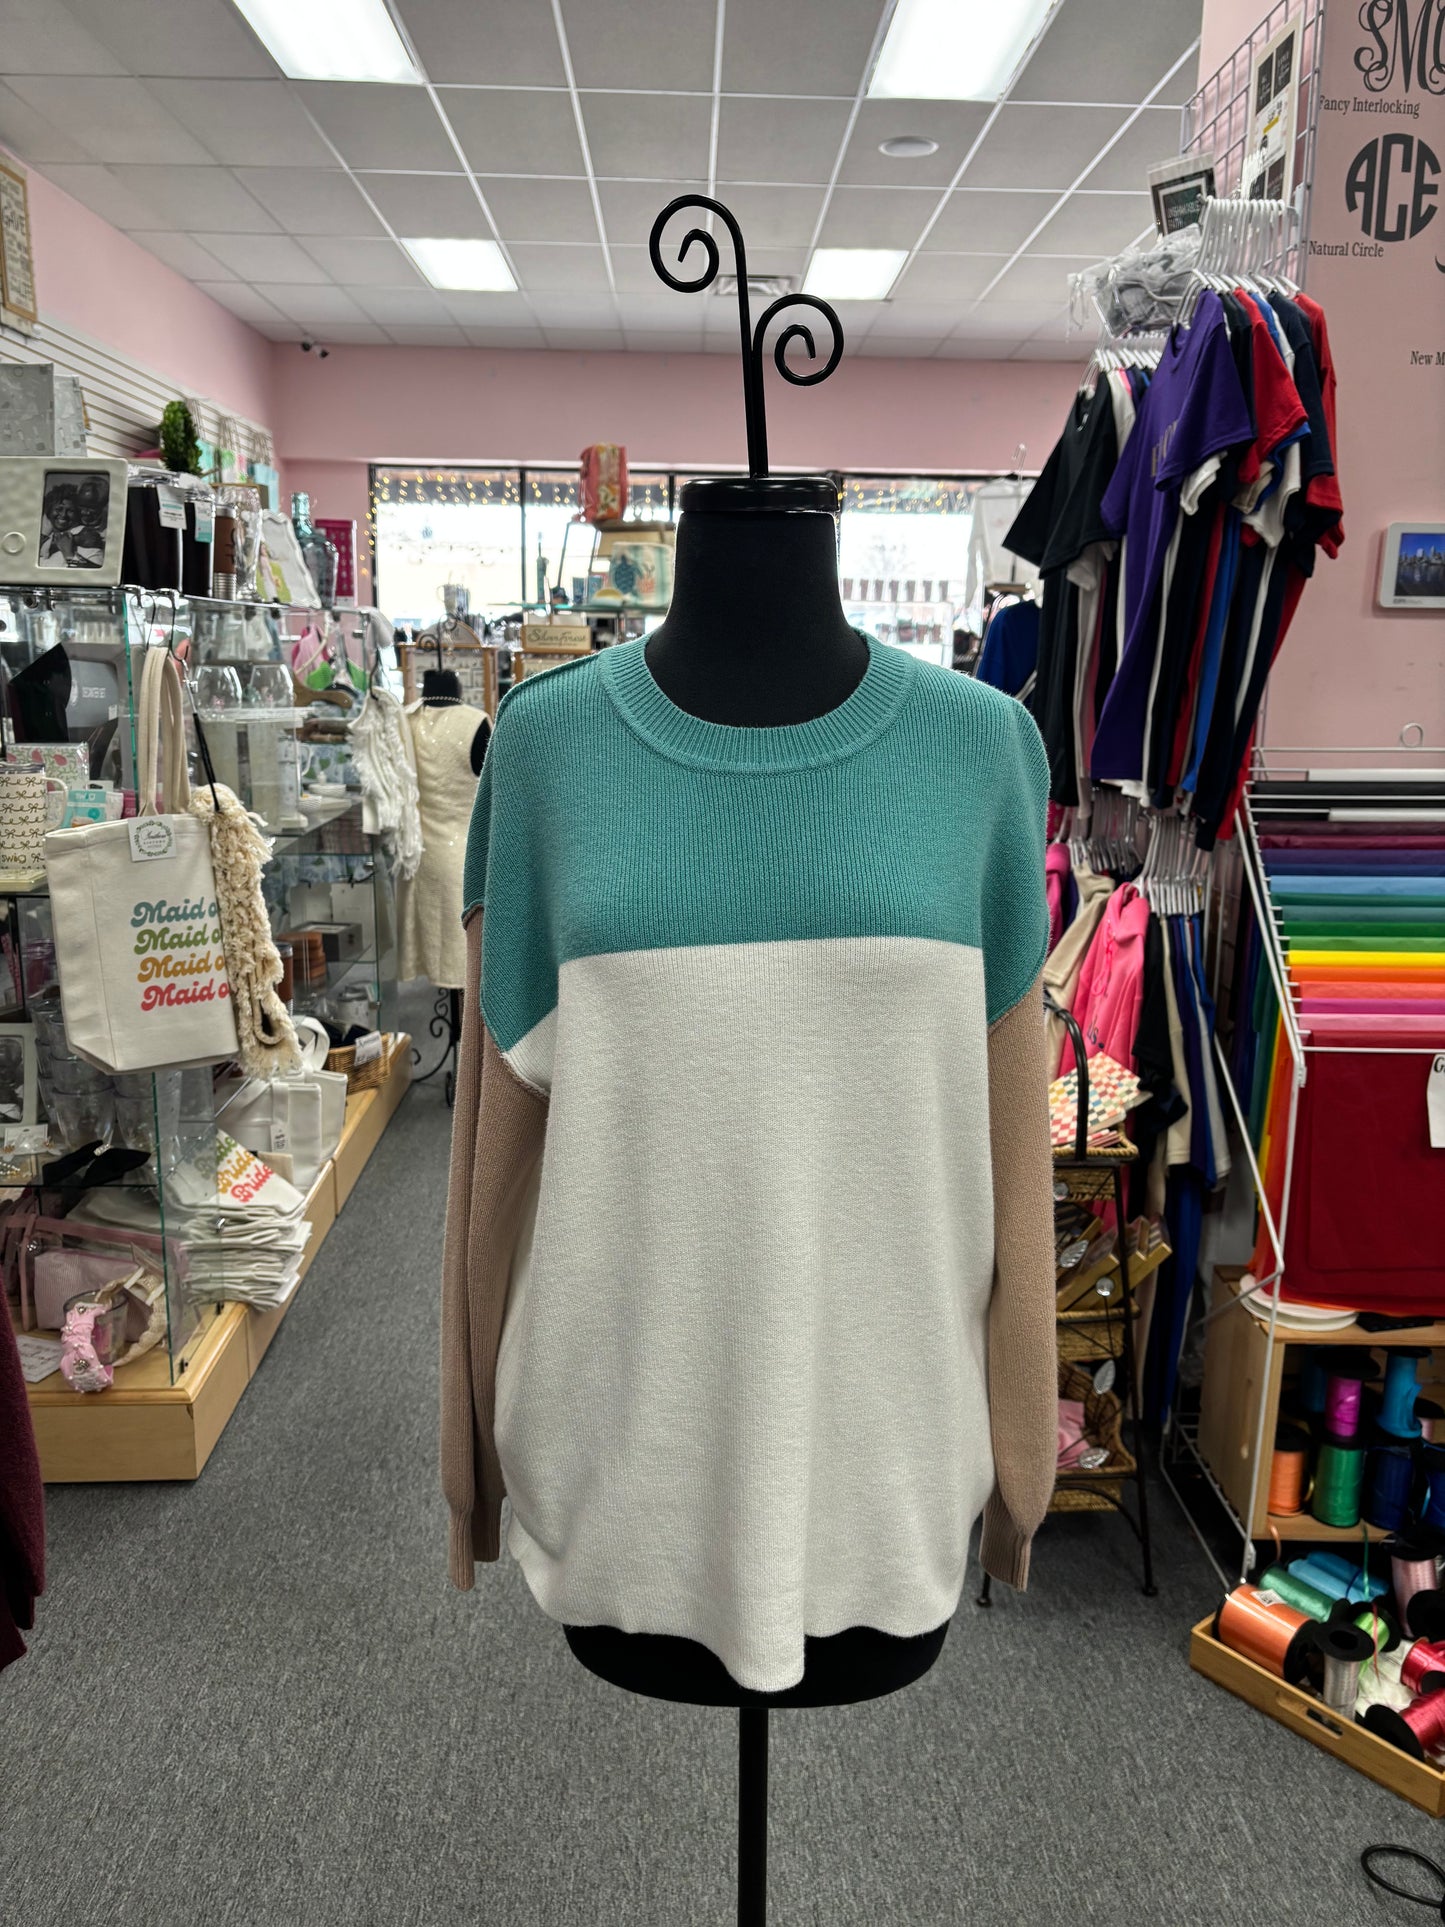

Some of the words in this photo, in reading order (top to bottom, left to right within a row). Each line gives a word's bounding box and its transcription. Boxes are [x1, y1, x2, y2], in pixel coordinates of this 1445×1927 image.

[1352, 97, 1420, 119] Interlocking
[1345, 133, 1442, 242] ACE
[1308, 240, 1349, 257] Natural
[1351, 241, 1385, 258] Circle
[1410, 350, 1434, 366] New
[130, 896, 206, 928] Maid
[207, 902, 218, 918] o
[133, 923, 210, 955] Maid
[211, 928, 221, 944] o
[137, 950, 213, 983] Maid
[214, 955, 226, 971] o
[140, 978, 216, 1011] Maid
[217, 982, 230, 999] o
[216, 1150, 256, 1194] Bride
[230, 1163, 274, 1203] Bride
